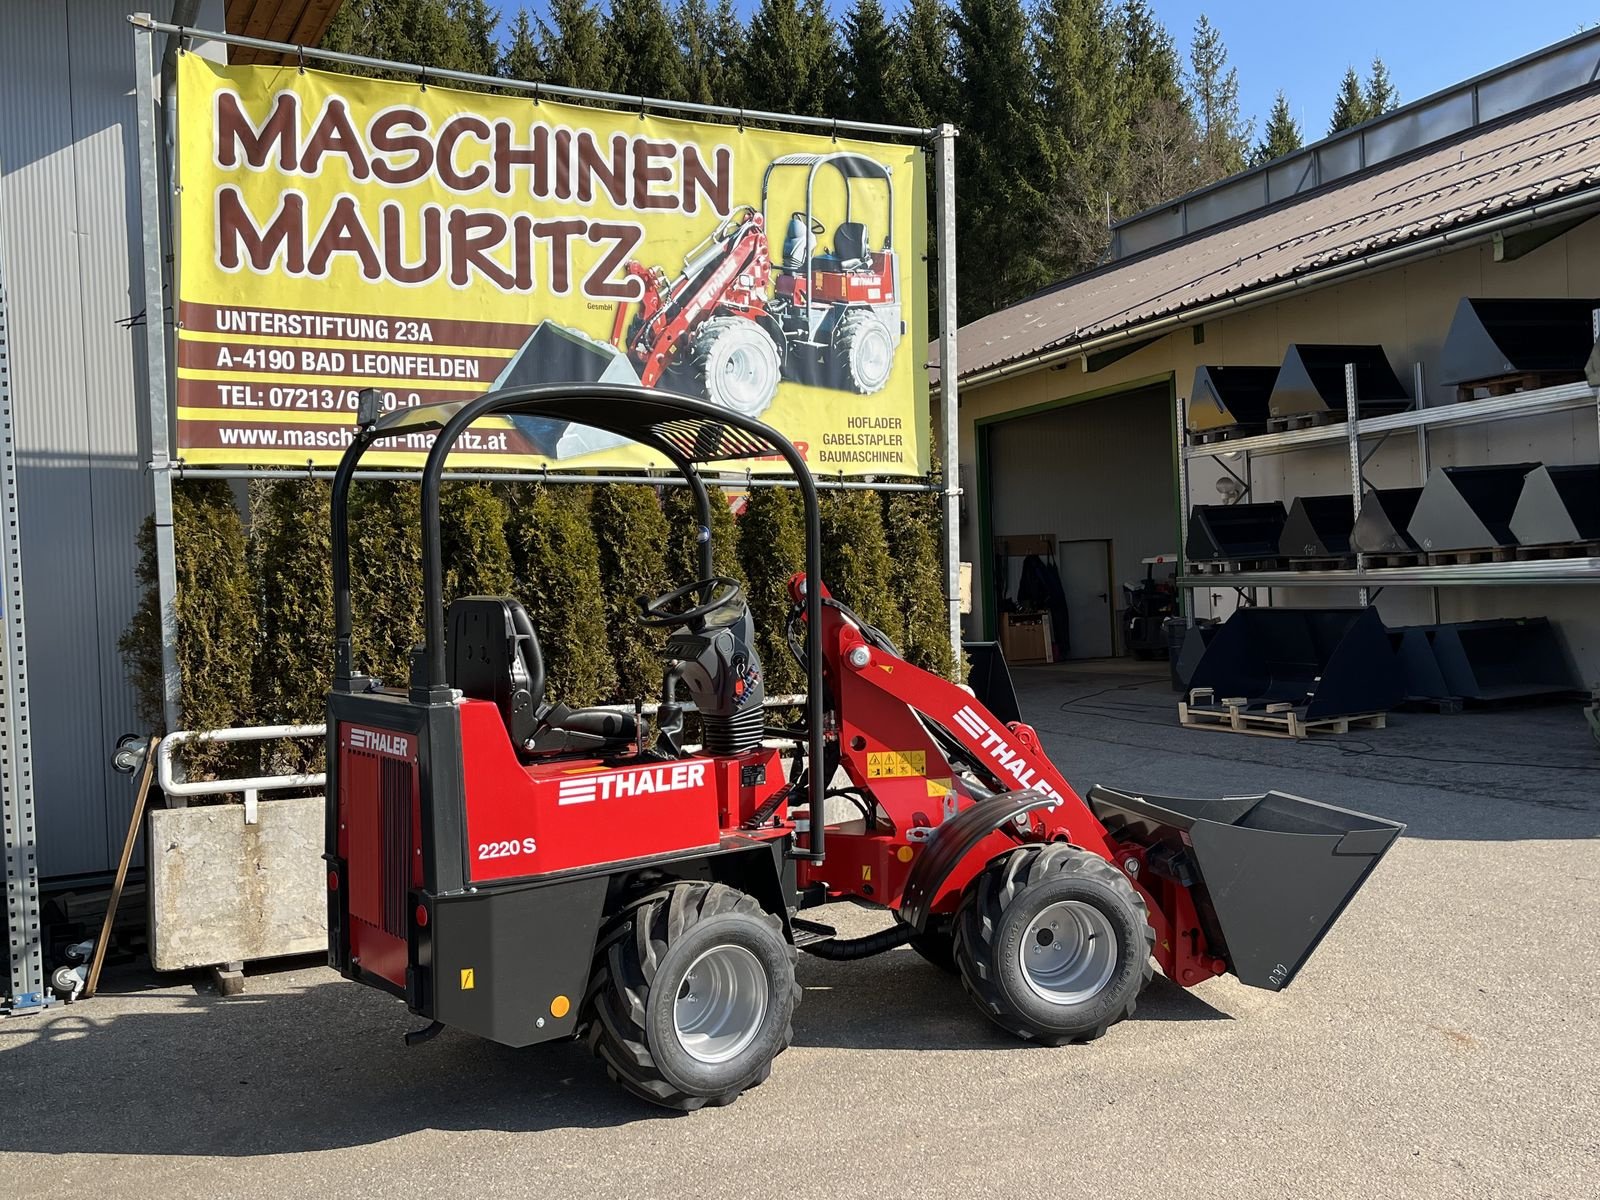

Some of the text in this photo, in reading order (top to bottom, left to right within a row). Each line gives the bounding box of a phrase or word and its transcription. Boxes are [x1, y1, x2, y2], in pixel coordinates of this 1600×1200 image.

[216, 91, 733, 218] MASCHINEN
[217, 186, 644, 300] MAURITZ
[586, 302, 613, 312] GesmbH
[216, 309, 434, 342] UNTERSTIFTUNG 23A
[216, 346, 480, 378] A-4190 BAD LEONFELDEN
[217, 384, 421, 412] TEL: 07213/60-0
[847, 416, 902, 430] HOFLADER
[822, 432, 903, 447] GABELSTAPLER
[819, 450, 904, 463] BAUMASCHINEN
[478, 837, 537, 860] 2220 S
